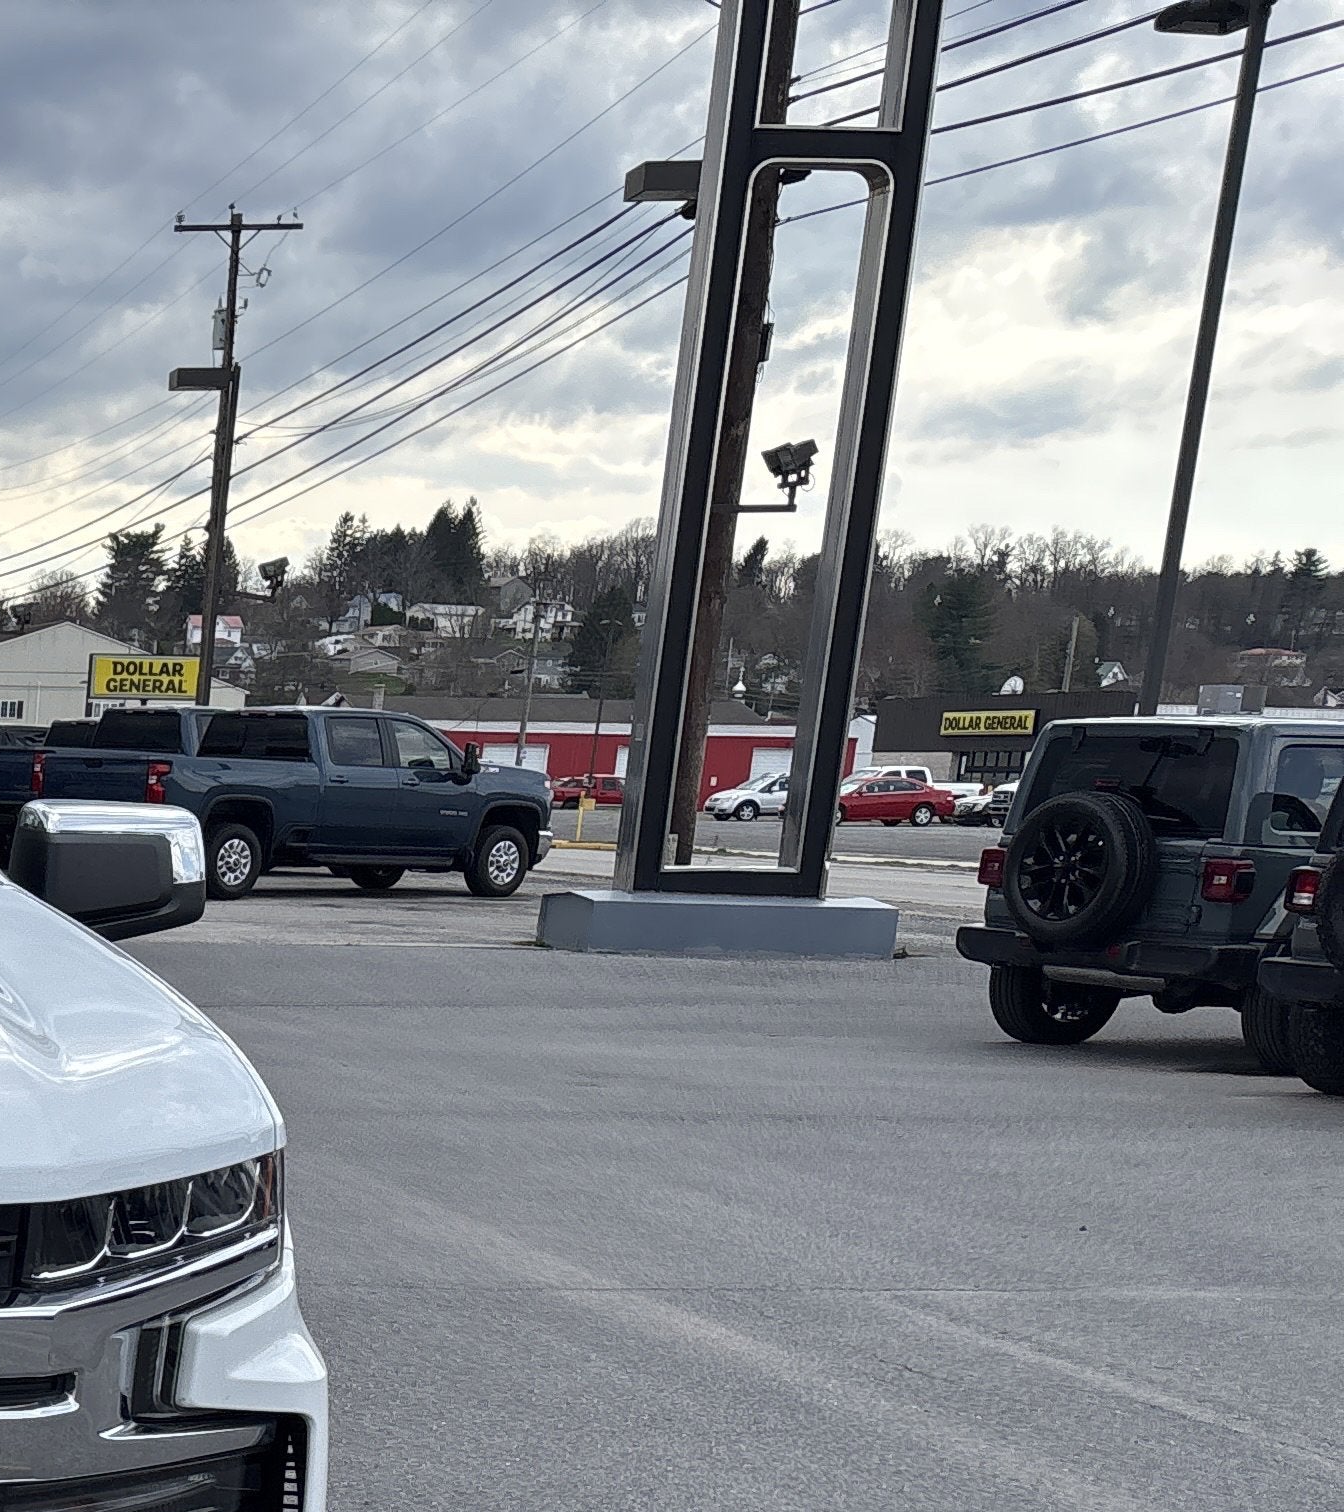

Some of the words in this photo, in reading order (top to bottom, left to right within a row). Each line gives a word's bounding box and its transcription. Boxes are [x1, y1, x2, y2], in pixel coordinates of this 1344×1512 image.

[111, 660, 185, 678] DOLLAR
[105, 677, 188, 694] GENERAL
[943, 716, 982, 732] DOLLAR
[983, 714, 1030, 731] GENERAL
